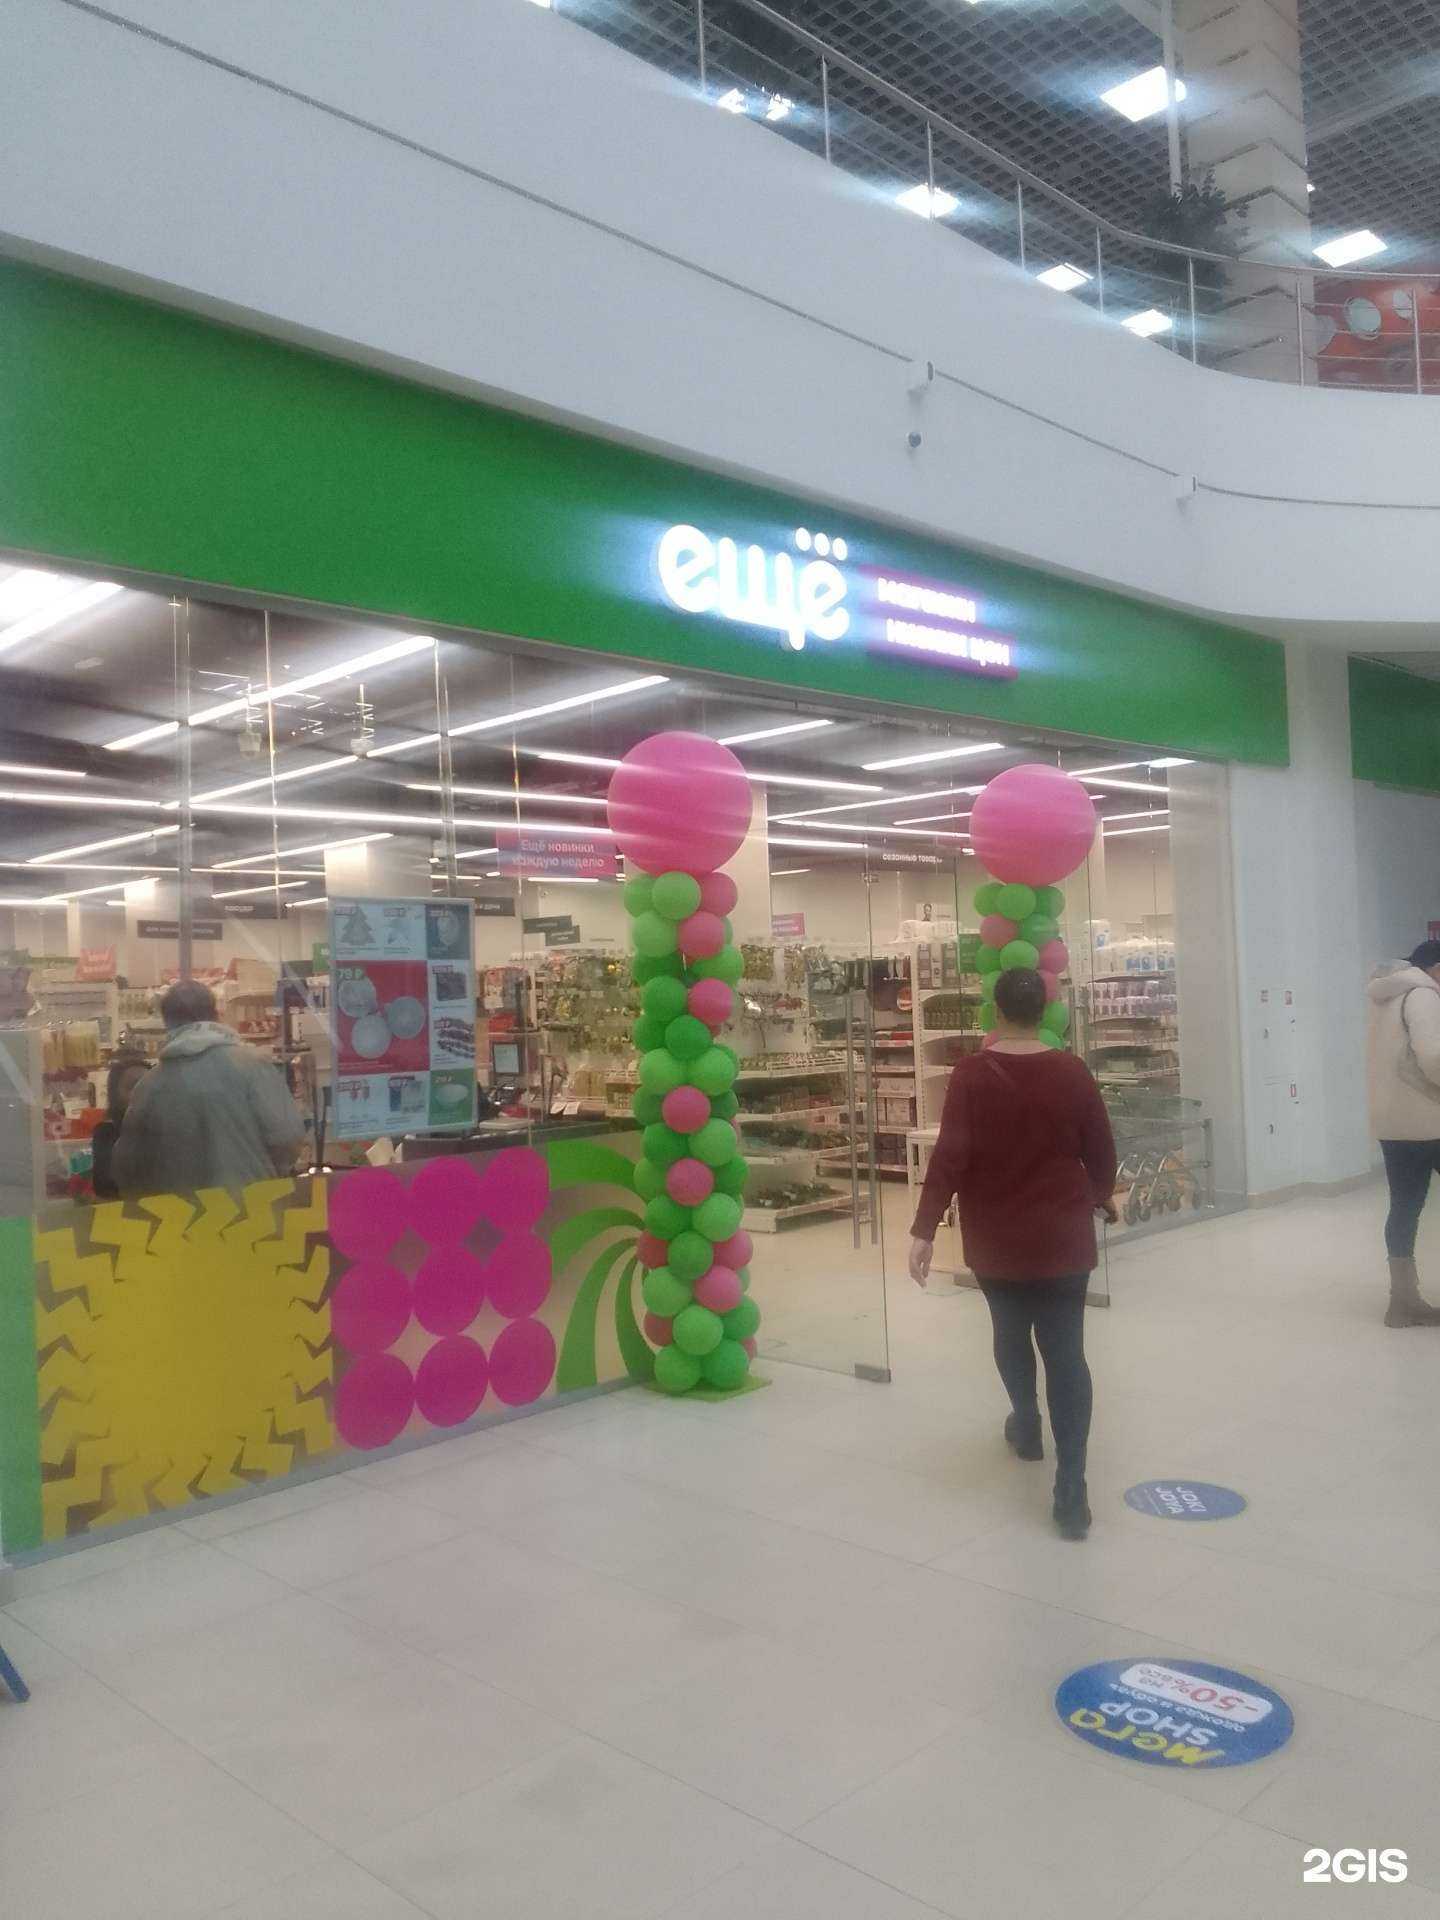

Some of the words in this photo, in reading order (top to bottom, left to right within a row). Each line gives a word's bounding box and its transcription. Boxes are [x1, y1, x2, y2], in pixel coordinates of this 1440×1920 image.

[521, 838, 545, 853] Ещё
[547, 842, 595, 853] новинки
[511, 856, 559, 869] каждую
[560, 857, 605, 869] неделю
[1099, 1701, 1218, 1746] SHOP
